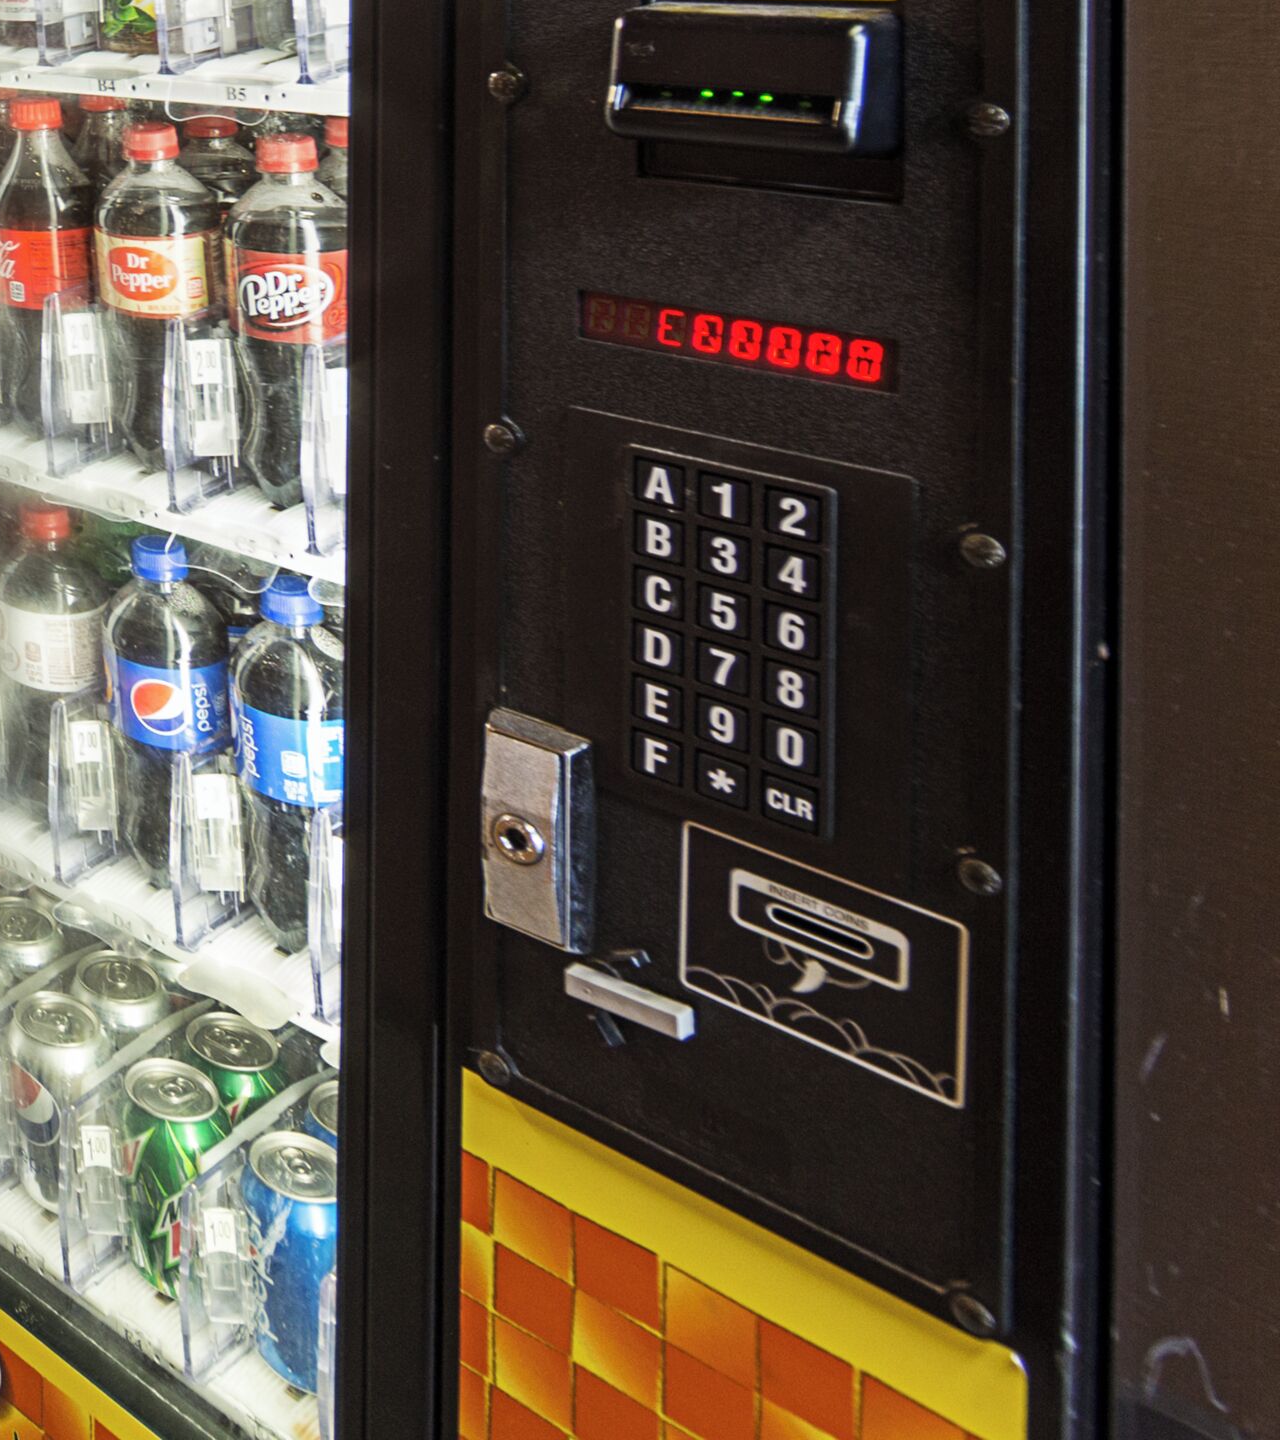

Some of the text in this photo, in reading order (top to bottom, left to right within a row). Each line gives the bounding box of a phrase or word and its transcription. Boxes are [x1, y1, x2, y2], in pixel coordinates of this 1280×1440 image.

[98, 79, 116, 93] B4
[226, 86, 247, 102] B5
[111, 264, 174, 293] Pepper
[127, 252, 150, 269] Dr
[247, 274, 326, 320] Pepper
[267, 271, 302, 298] Dr
[644, 466, 674, 505] A
[711, 482, 733, 518] 1
[779, 497, 807, 537] 2
[645, 519, 671, 558] B
[710, 537, 737, 575] 3
[645, 575, 671, 613] C
[778, 556, 807, 594] 4
[710, 592, 737, 631] 5
[643, 627, 671, 667] D
[777, 612, 805, 651] 6
[709, 647, 736, 686] 7
[192, 683, 212, 732] pepsi
[644, 682, 669, 724] E
[776, 669, 805, 709] 8
[709, 705, 735, 744] 9
[240, 714, 260, 779] pepsi
[643, 737, 668, 775] F
[776, 726, 804, 767] 0
[765, 788, 814, 822] CLR
[768, 883, 870, 931] INSERT COINS
